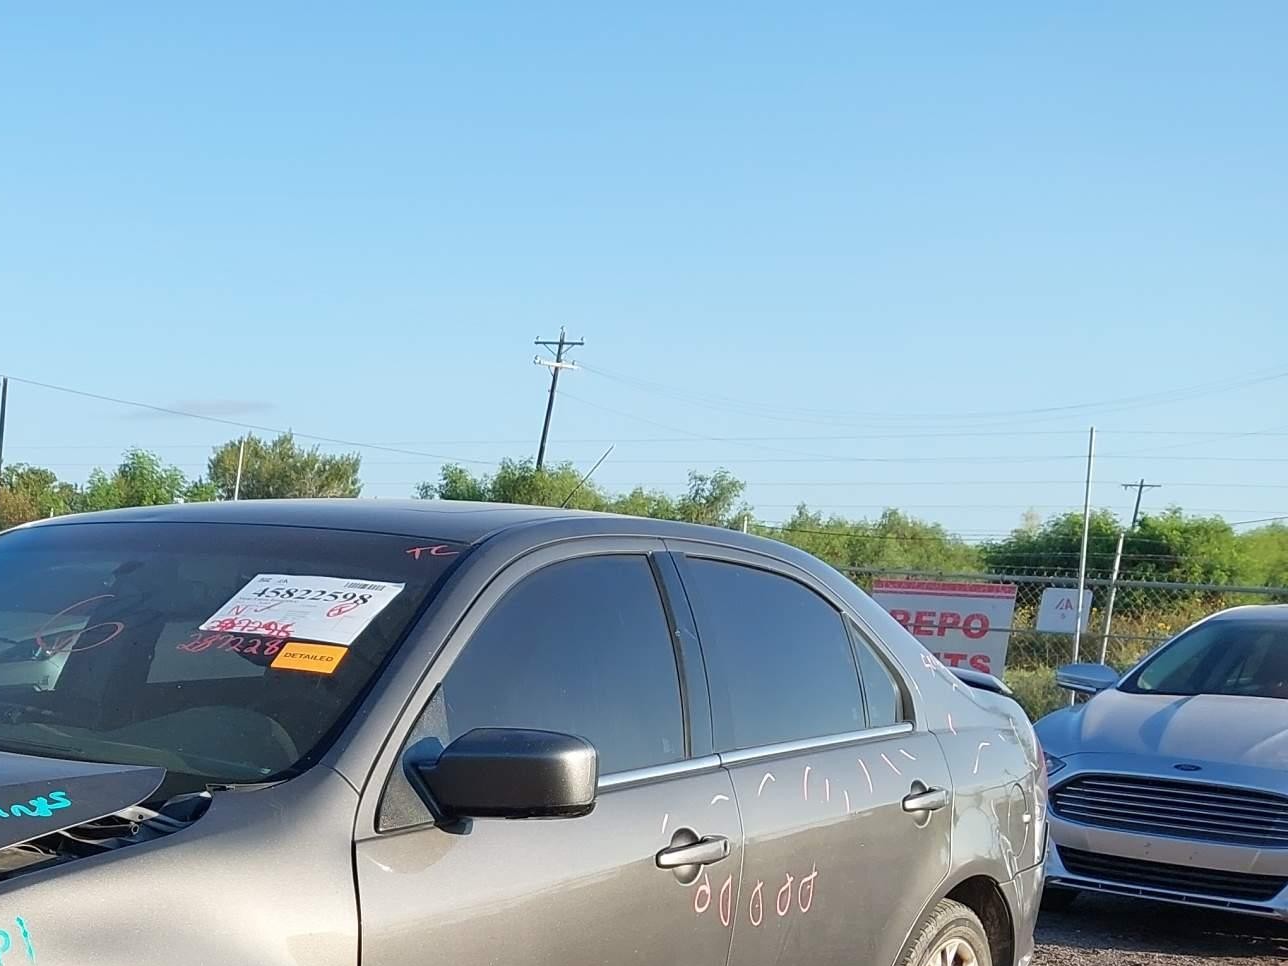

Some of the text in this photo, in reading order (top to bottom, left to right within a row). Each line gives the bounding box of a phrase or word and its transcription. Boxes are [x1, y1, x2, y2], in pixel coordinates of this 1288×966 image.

[252, 586, 373, 606] 45822598
[889, 608, 990, 639] REPO
[283, 651, 335, 663] DETAILED
